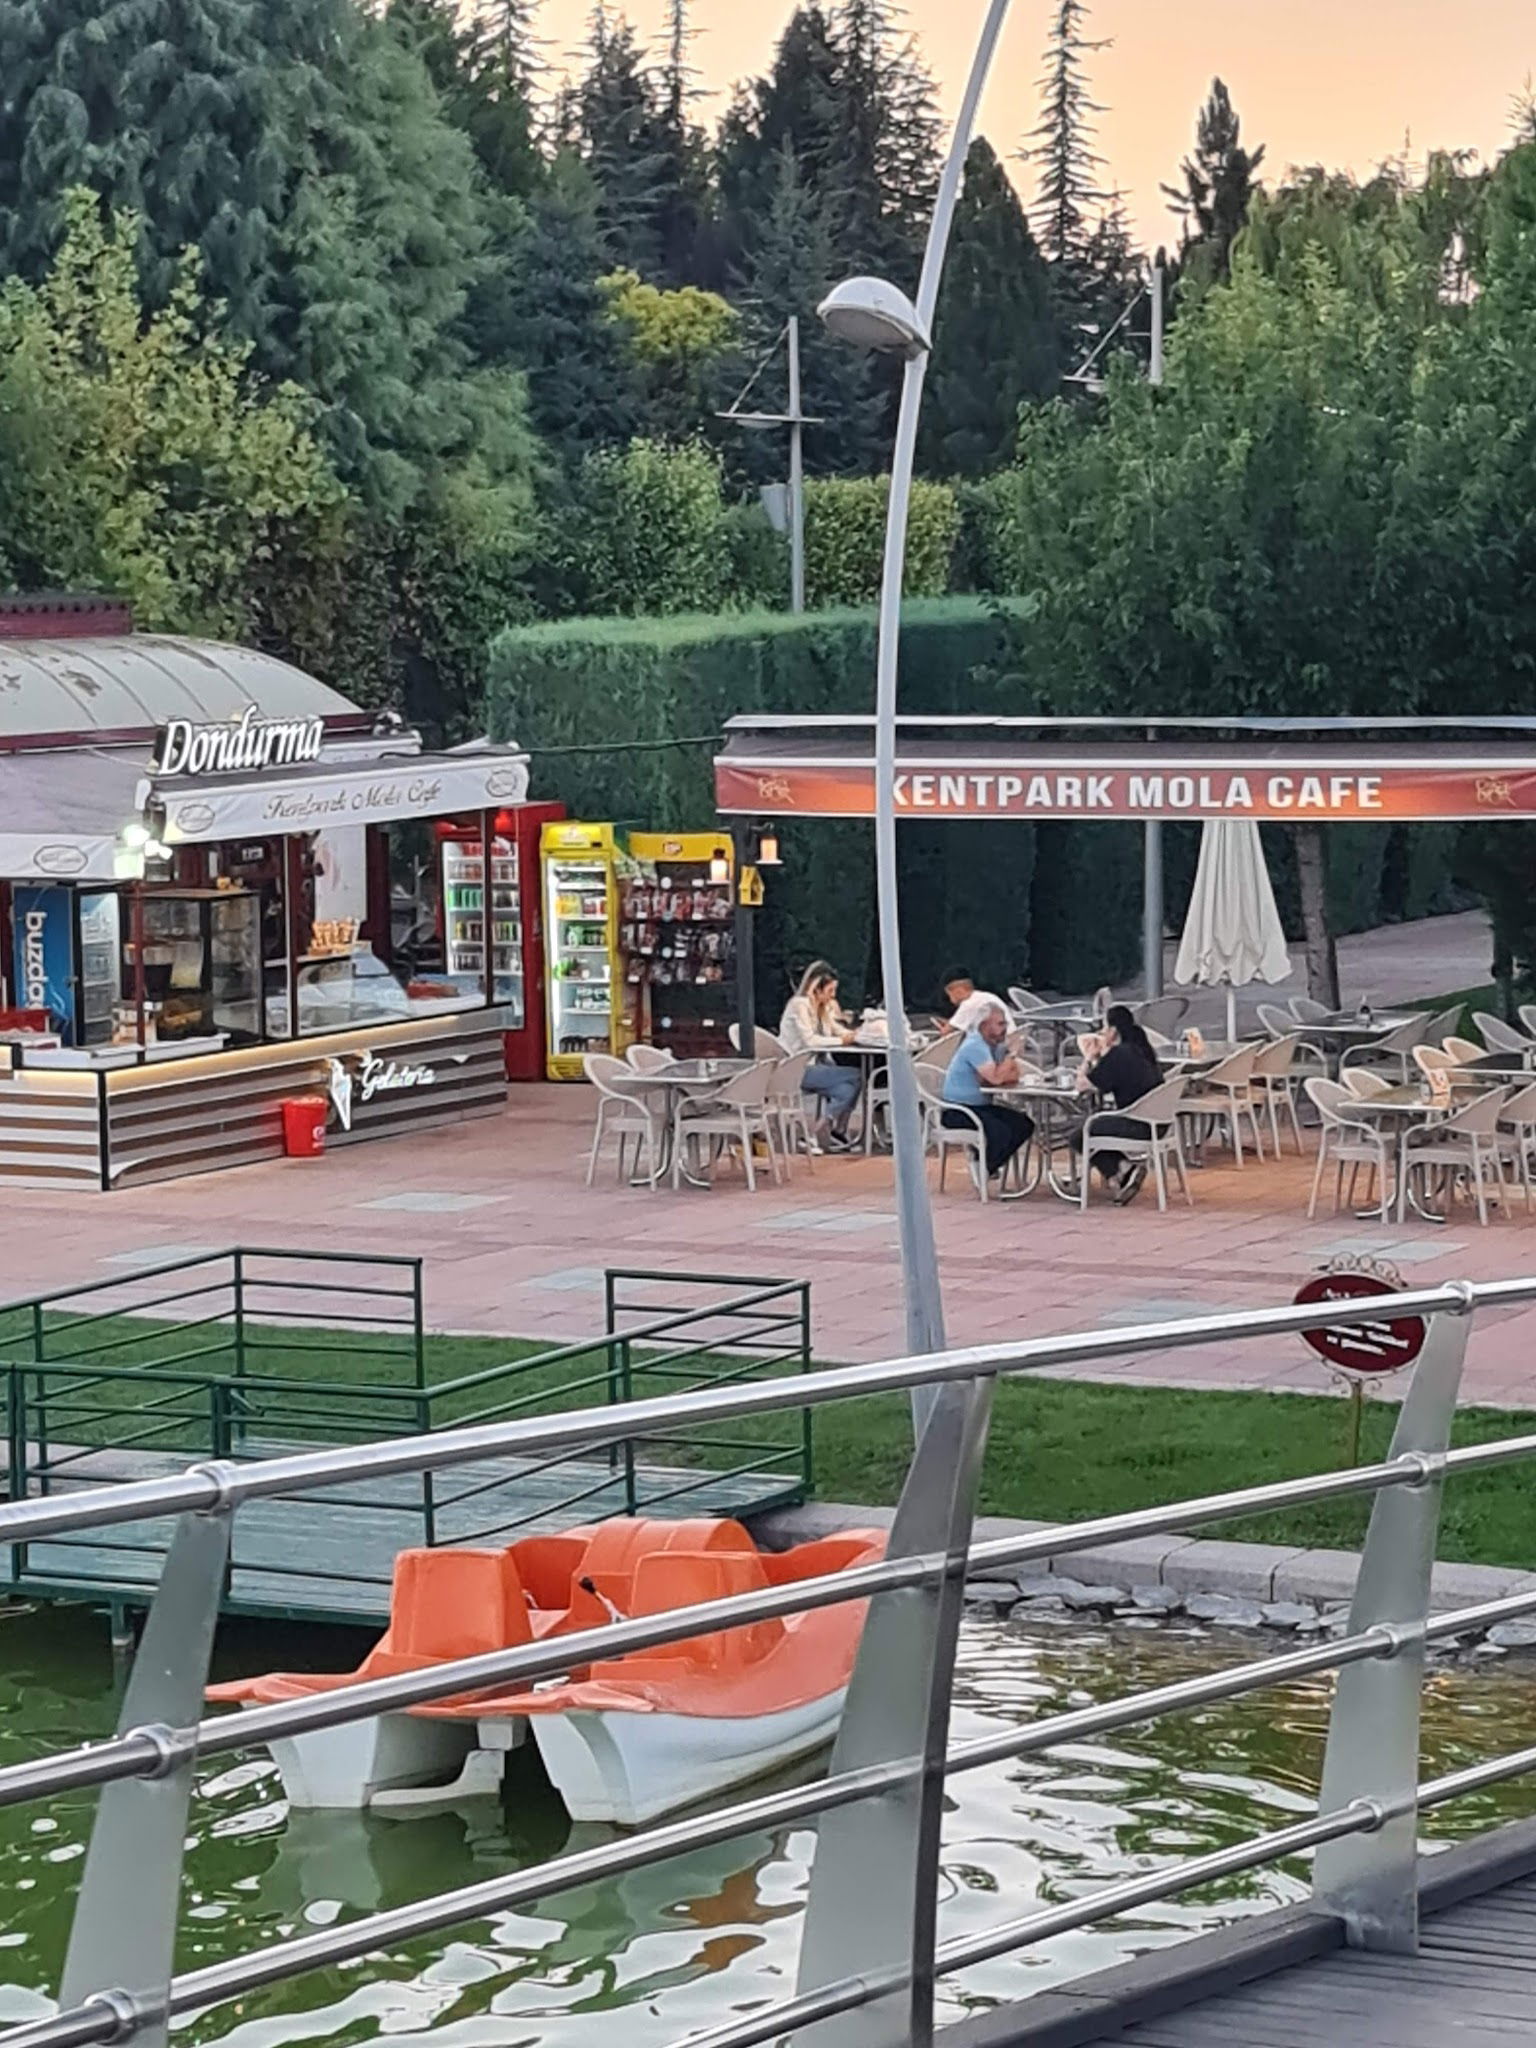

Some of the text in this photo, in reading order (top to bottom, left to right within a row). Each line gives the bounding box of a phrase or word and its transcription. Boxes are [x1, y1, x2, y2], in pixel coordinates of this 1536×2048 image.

[160, 703, 325, 775] Dondurma
[1128, 775, 1253, 808] MOLA
[1267, 775, 1383, 808] CAFE
